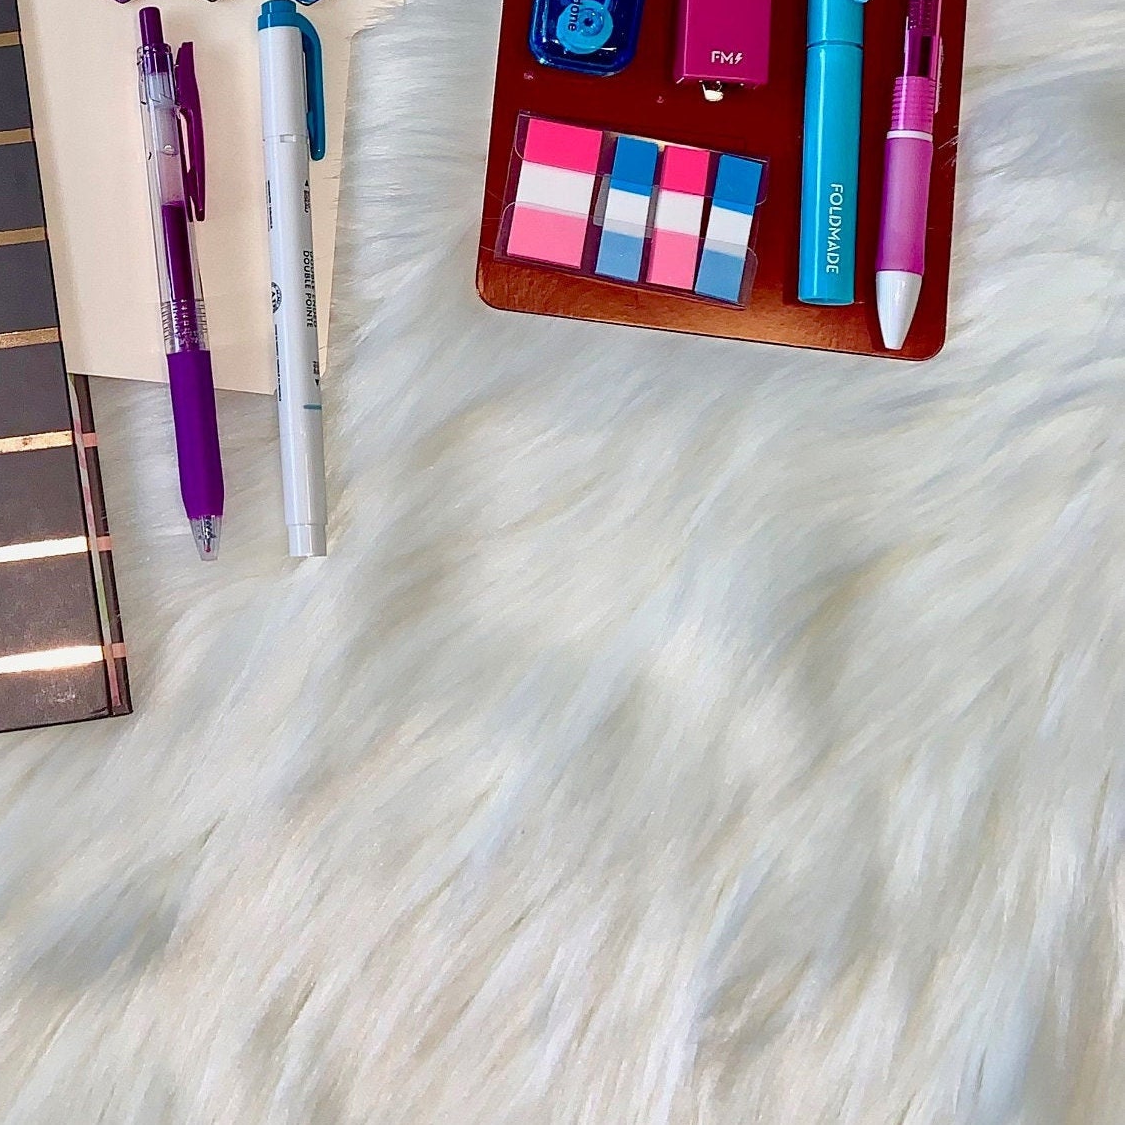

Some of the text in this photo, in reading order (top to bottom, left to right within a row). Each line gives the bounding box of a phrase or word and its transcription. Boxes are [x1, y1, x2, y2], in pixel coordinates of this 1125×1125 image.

[825, 183, 844, 274] FOLDMADE
[303, 250, 314, 328] DOUBLE POINTE
